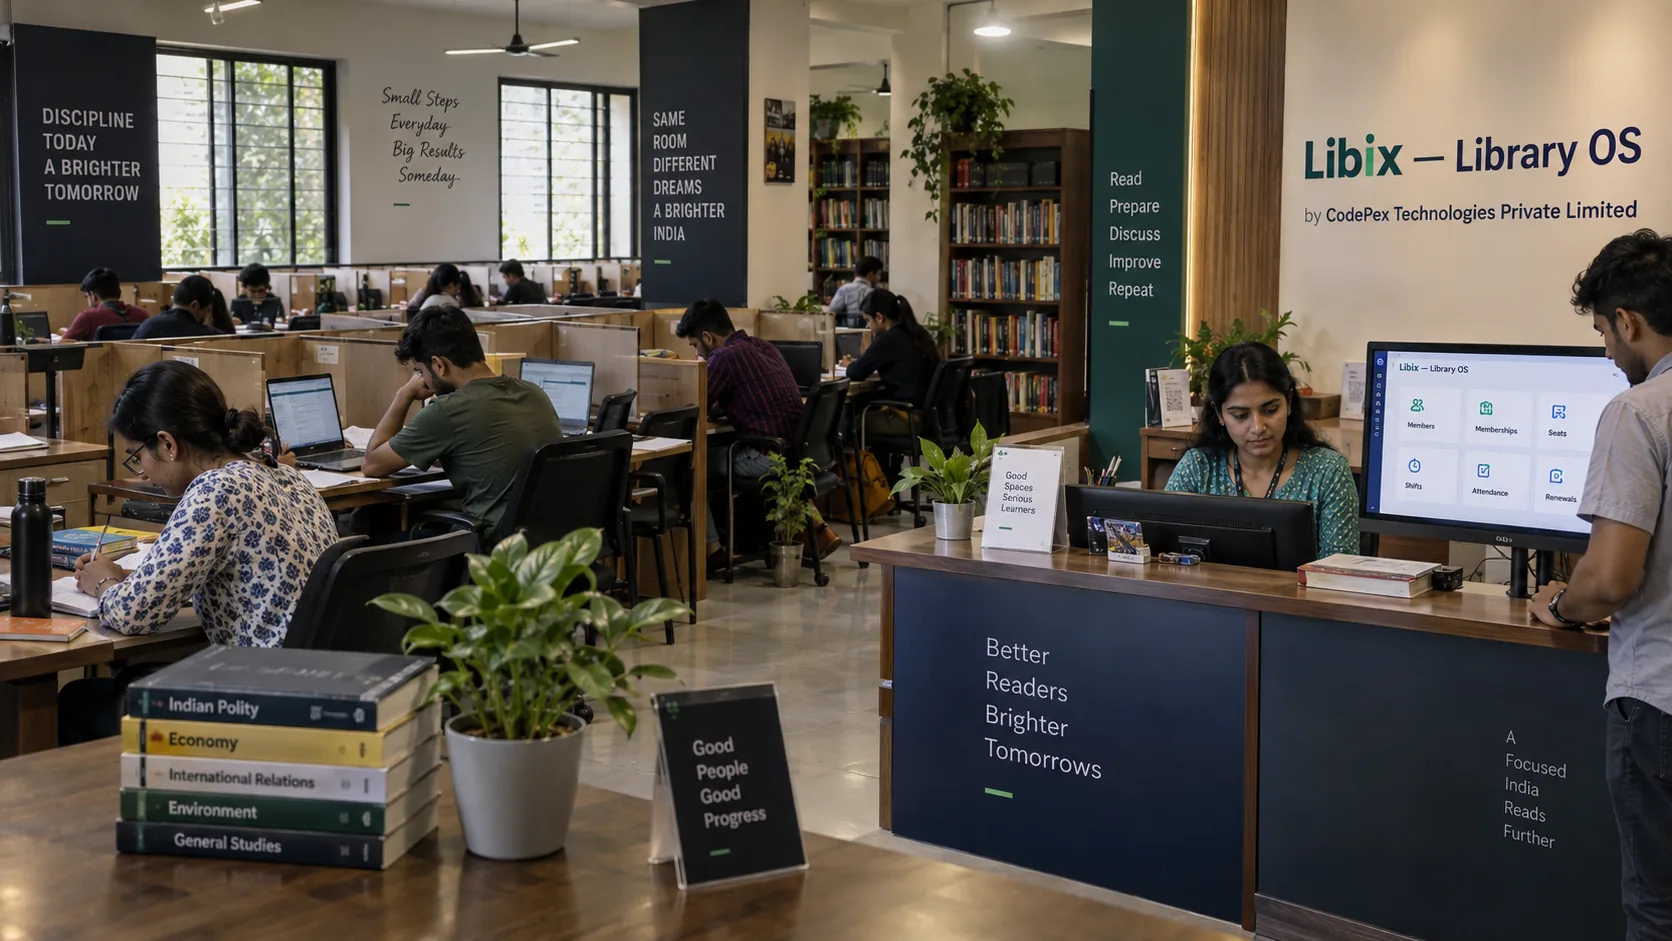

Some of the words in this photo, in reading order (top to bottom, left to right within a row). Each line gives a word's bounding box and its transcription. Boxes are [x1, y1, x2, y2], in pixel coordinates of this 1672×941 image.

[382, 87, 421, 105] Small
[426, 90, 460, 113] Steps
[43, 108, 134, 128] DISCIPLINE
[391, 113, 453, 137] Everyday
[653, 111, 685, 127] SAME
[43, 133, 96, 151] TODAY
[654, 133, 686, 149] ROOM
[393, 140, 415, 163] Big
[420, 141, 465, 159] Results
[1305, 134, 1403, 179] Libix
[1457, 137, 1578, 176] Library
[1589, 127, 1641, 165] OS
[44, 158, 56, 175] A
[62, 159, 140, 177] BRIGHTER
[654, 155, 716, 172] DIFFERENT
[399, 166, 460, 189] Someday
[1111, 170, 1141, 186] Read
[45, 184, 138, 201] TOMORROW
[654, 179, 701, 195] DREAMS
[653, 202, 662, 219] A
[666, 203, 724, 218] BRIGHTER
[1110, 199, 1159, 216] Prepare
[1305, 208, 1322, 226] by
[1327, 207, 1389, 222] CodePex
[1394, 204, 1495, 224] Technologies
[1501, 203, 1560, 219] Private
[1567, 200, 1637, 218] Limited
[654, 226, 685, 241] INDIA
[1110, 226, 1160, 241] Discuss
[1110, 254, 1161, 271] Improve
[1110, 281, 1153, 299] Repeat
[1399, 363, 1419, 372] Libix
[1430, 365, 1456, 375] Library
[1457, 365, 1469, 373] OS
[1407, 421, 1435, 430] Members
[1475, 425, 1518, 435] Memberships
[1548, 429, 1567, 437] Seats
[1005, 471, 1028, 480] Good
[1004, 482, 1034, 492] Spaces
[1405, 482, 1422, 491] Shifts
[1472, 487, 1509, 497] Attendance
[1002, 493, 1033, 503] Serious
[1545, 493, 1577, 503] Renewals
[1001, 504, 1036, 514] Learners
[987, 638, 1049, 664] Better
[987, 671, 1067, 702] Readers
[169, 697, 214, 713] Indian
[218, 700, 260, 720] Polity
[987, 704, 1068, 736] Brighter
[168, 732, 239, 752] Economy
[692, 736, 735, 756] Good
[1505, 730, 1517, 745] A
[985, 738, 1101, 778] Tomorrows
[1506, 753, 1567, 778] Focused
[169, 768, 252, 786] International
[255, 773, 315, 790] Relations
[696, 760, 749, 781] People
[700, 784, 742, 804] Good
[1506, 777, 1539, 796] India
[168, 800, 257, 820] Environment
[704, 807, 767, 829] Progress
[1505, 801, 1545, 822] Reads
[174, 832, 227, 850] General
[230, 836, 282, 855] Studies
[1504, 824, 1555, 848] Further
